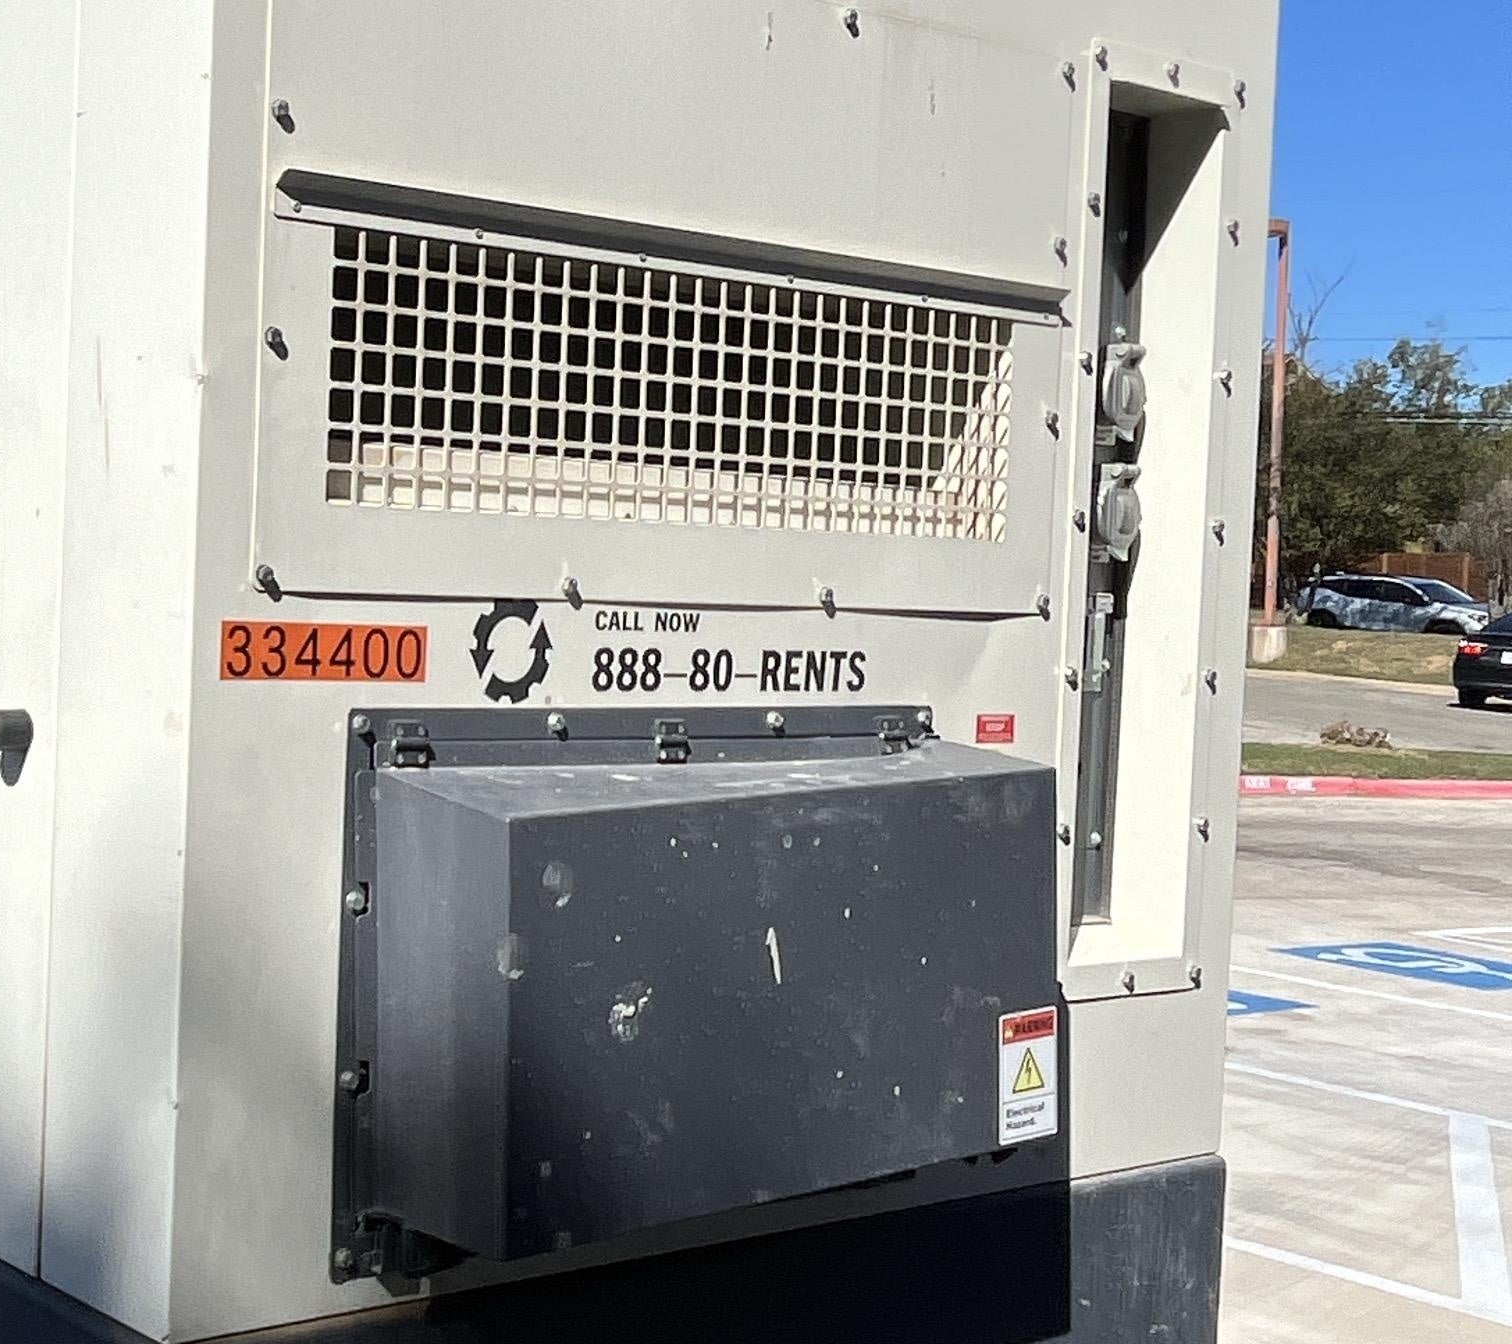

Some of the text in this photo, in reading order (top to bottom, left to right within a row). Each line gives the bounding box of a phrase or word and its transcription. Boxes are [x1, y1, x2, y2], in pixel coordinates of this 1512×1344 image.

[595, 611, 701, 634] CALL NOW
[225, 626, 424, 680] 334400
[591, 647, 867, 693] 888-80-RENTS
